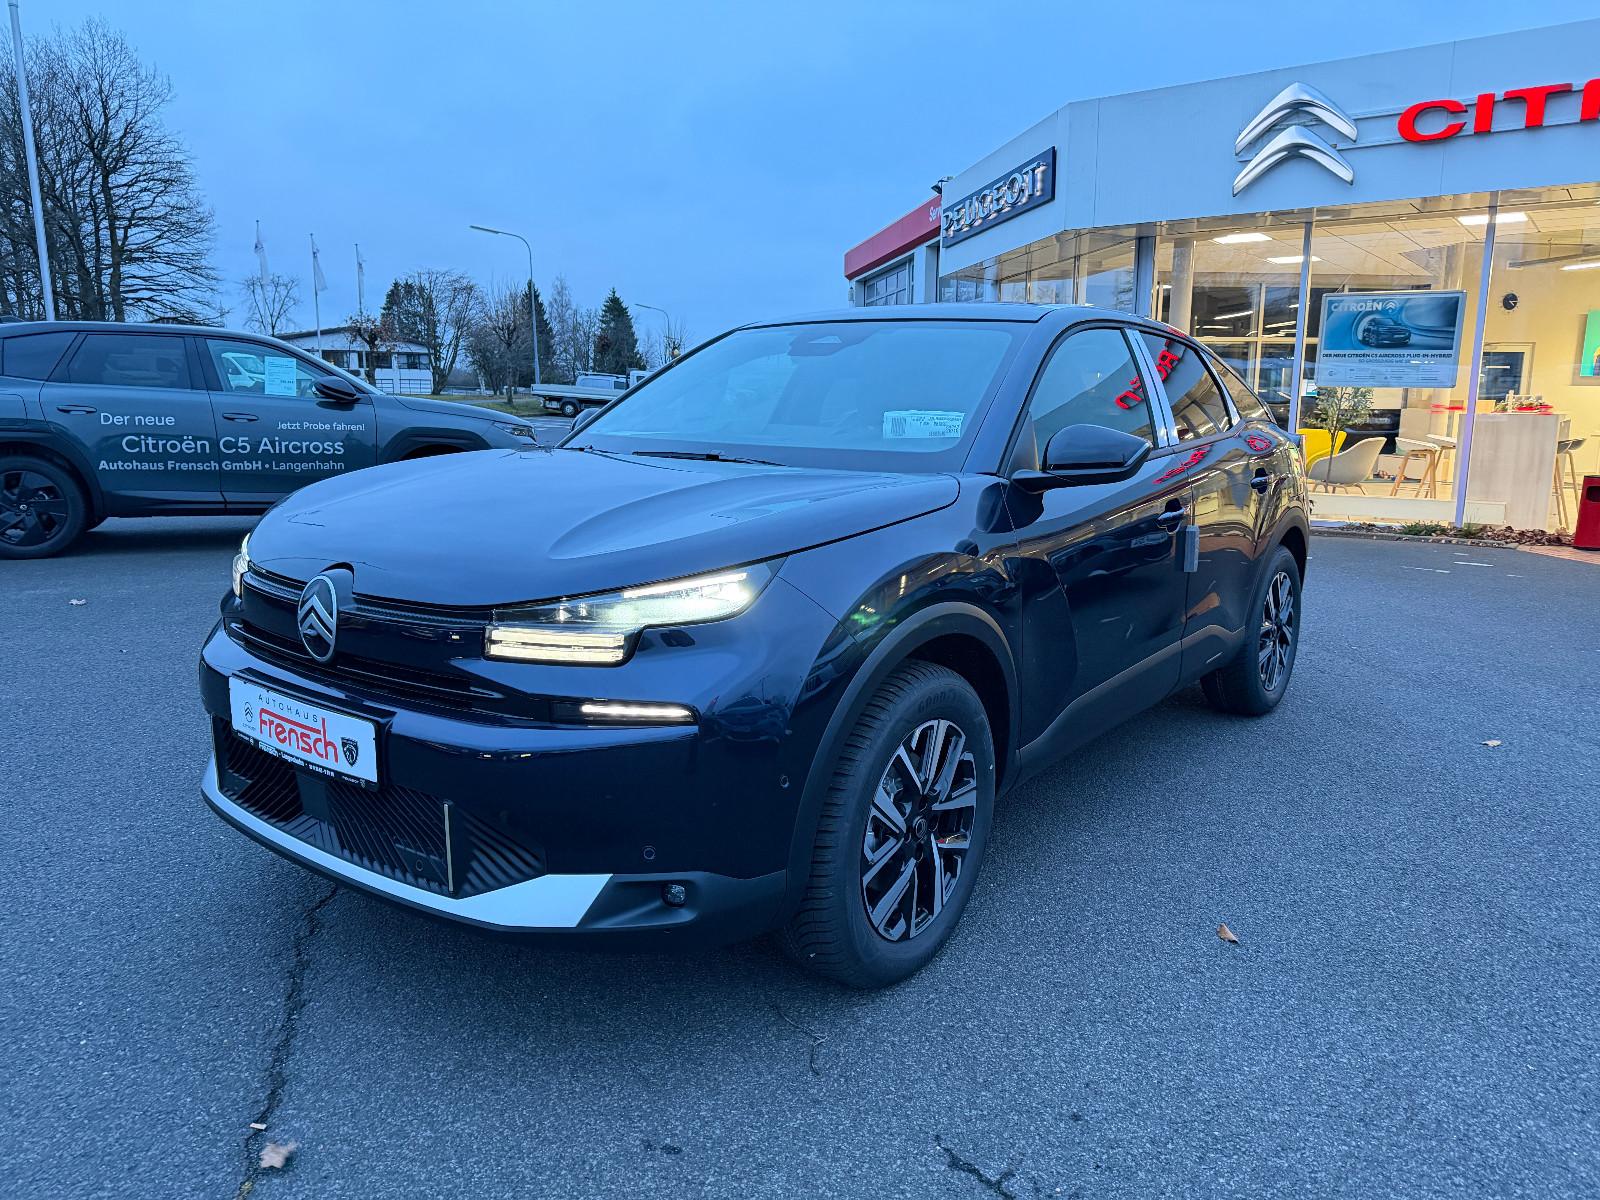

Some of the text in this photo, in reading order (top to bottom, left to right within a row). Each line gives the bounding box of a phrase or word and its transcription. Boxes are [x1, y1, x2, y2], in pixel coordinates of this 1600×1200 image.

[943, 160, 1048, 238] PEUGEOT
[1331, 300, 1383, 312] CITROËN
[100, 412, 176, 427] Der neue
[277, 421, 365, 431] Jetzt Probe fahren!
[121, 435, 345, 455] Citroën C5 Aircross
[99, 459, 345, 473] Autohaus Frensch GmbH Langenhahn
[258, 694, 318, 723] AUTOHAUS
[259, 708, 339, 764] Frensch
